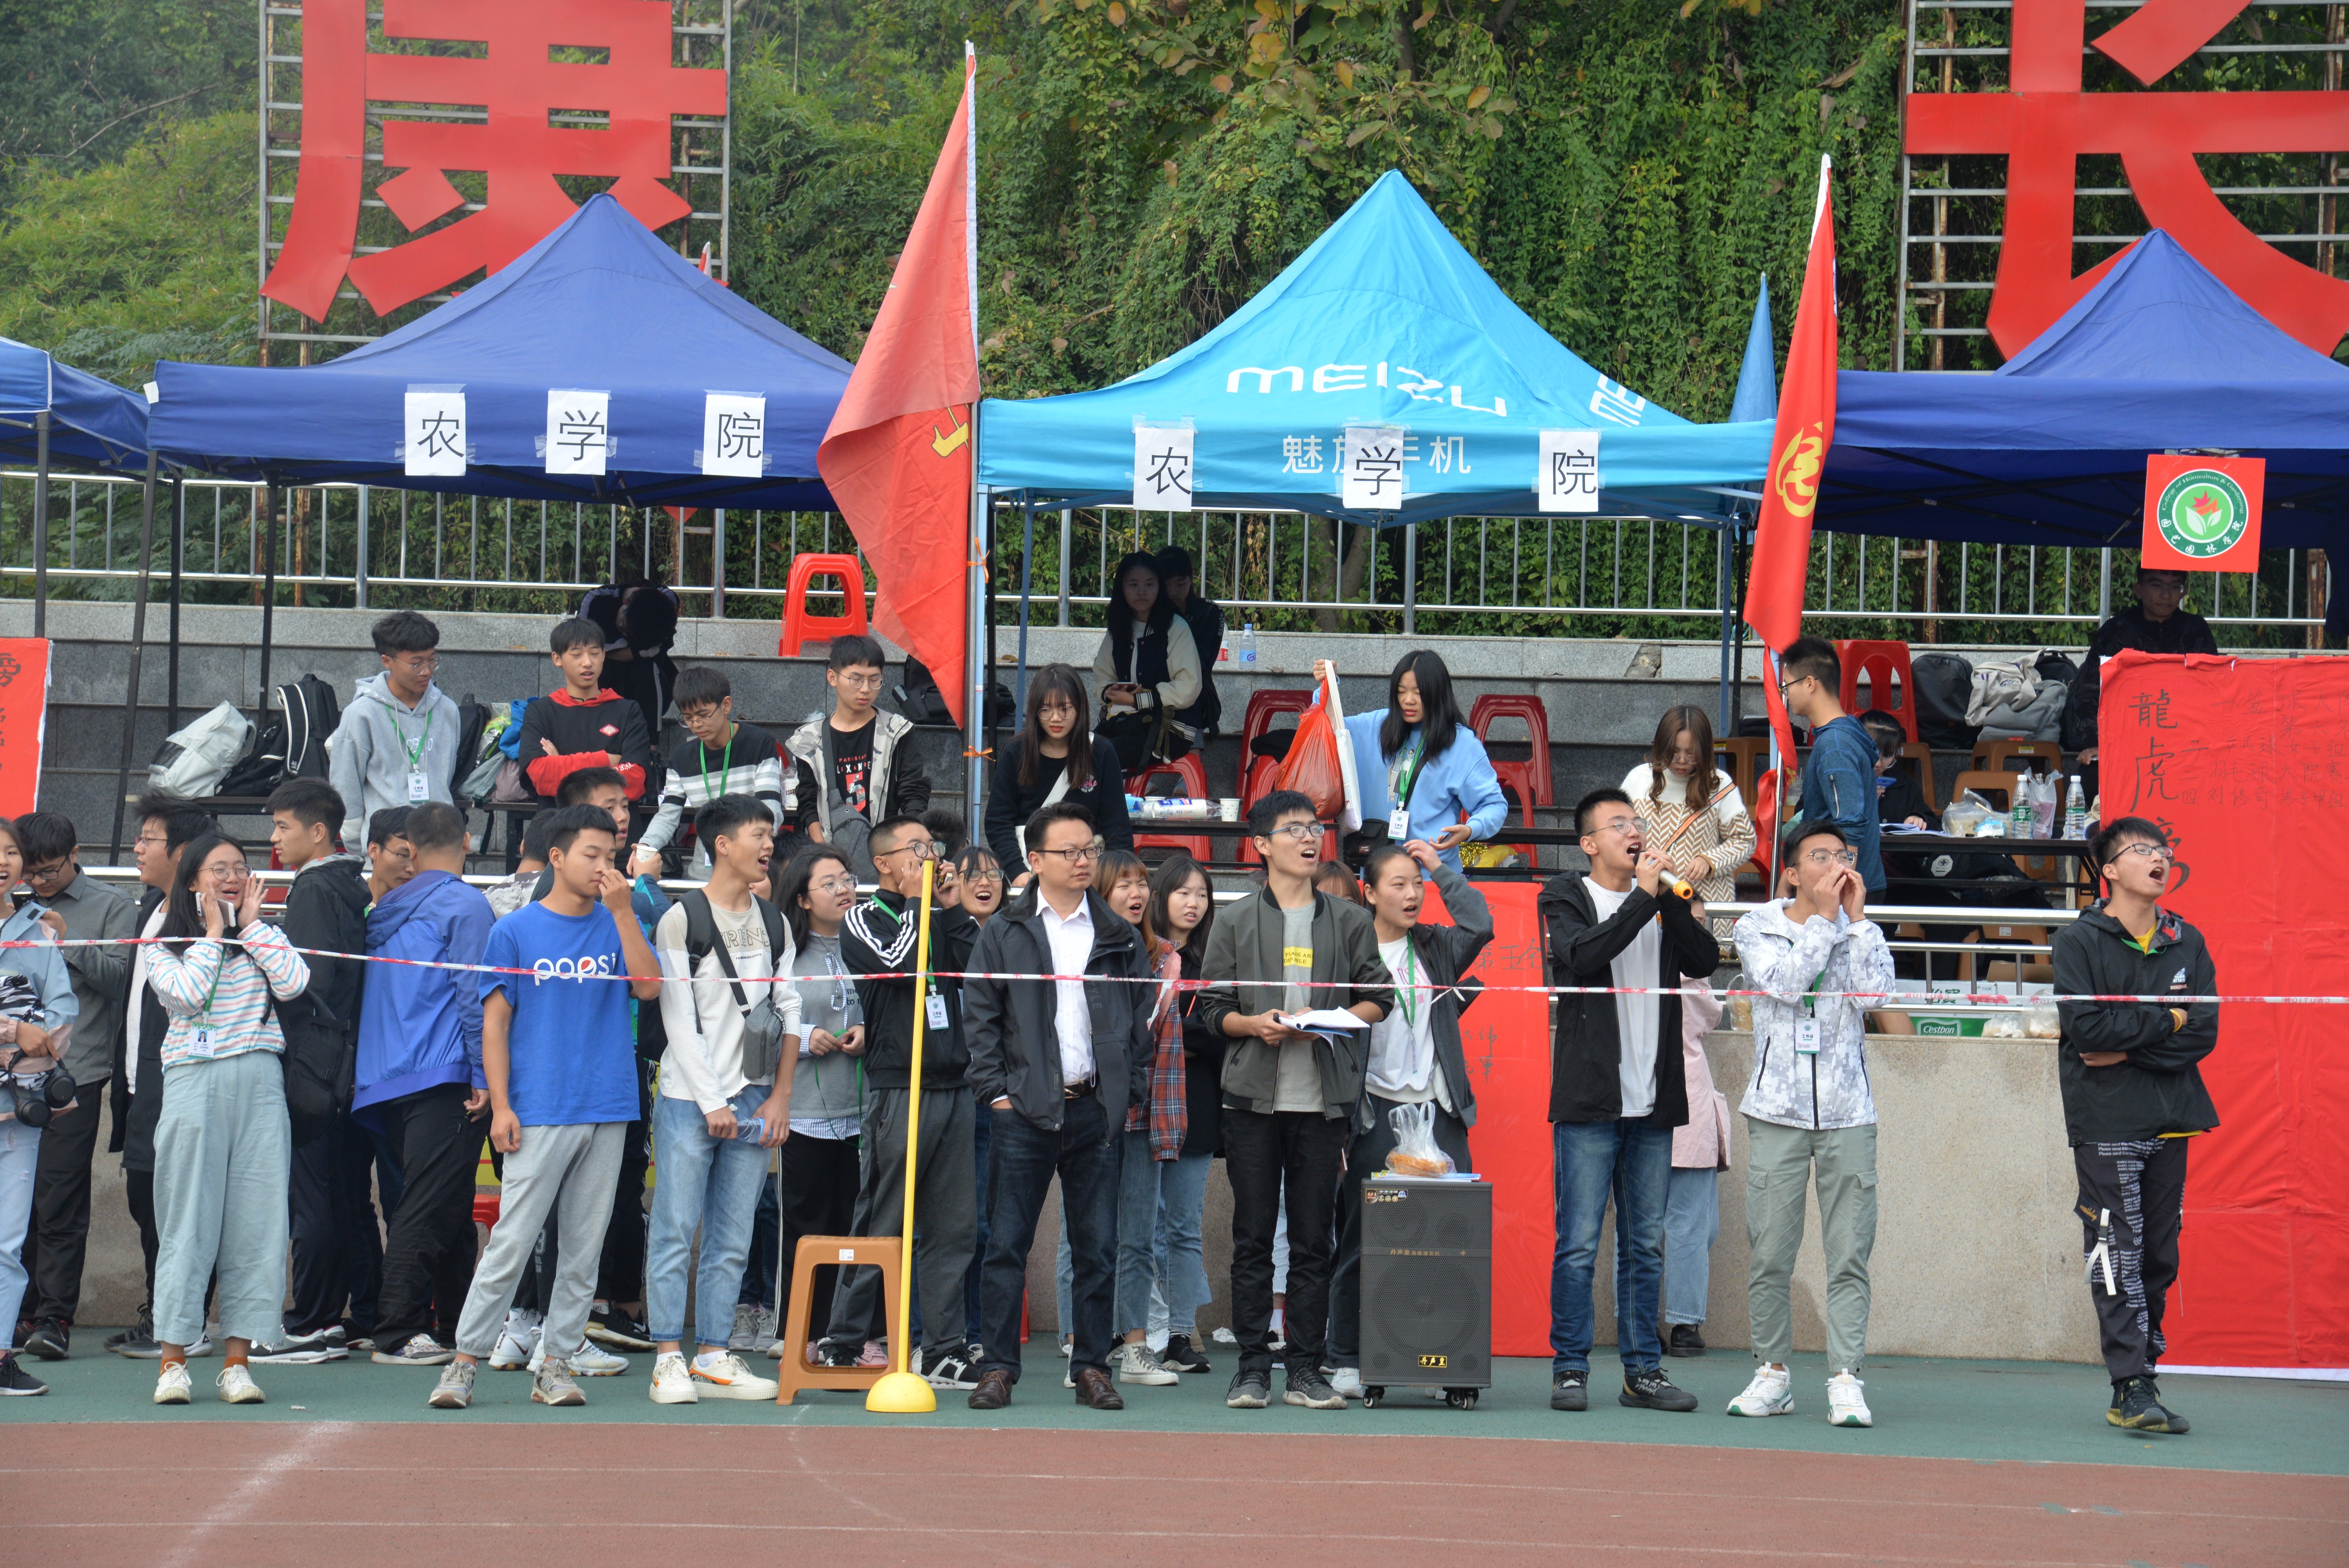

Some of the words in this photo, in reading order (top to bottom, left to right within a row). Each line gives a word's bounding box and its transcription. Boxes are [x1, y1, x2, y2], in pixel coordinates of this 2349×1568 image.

[2162, 487, 2175, 511] College
[2176, 480, 2182, 488] of
[2182, 474, 2220, 483] Horticulture
[2226, 482, 2244, 514] Gardening
